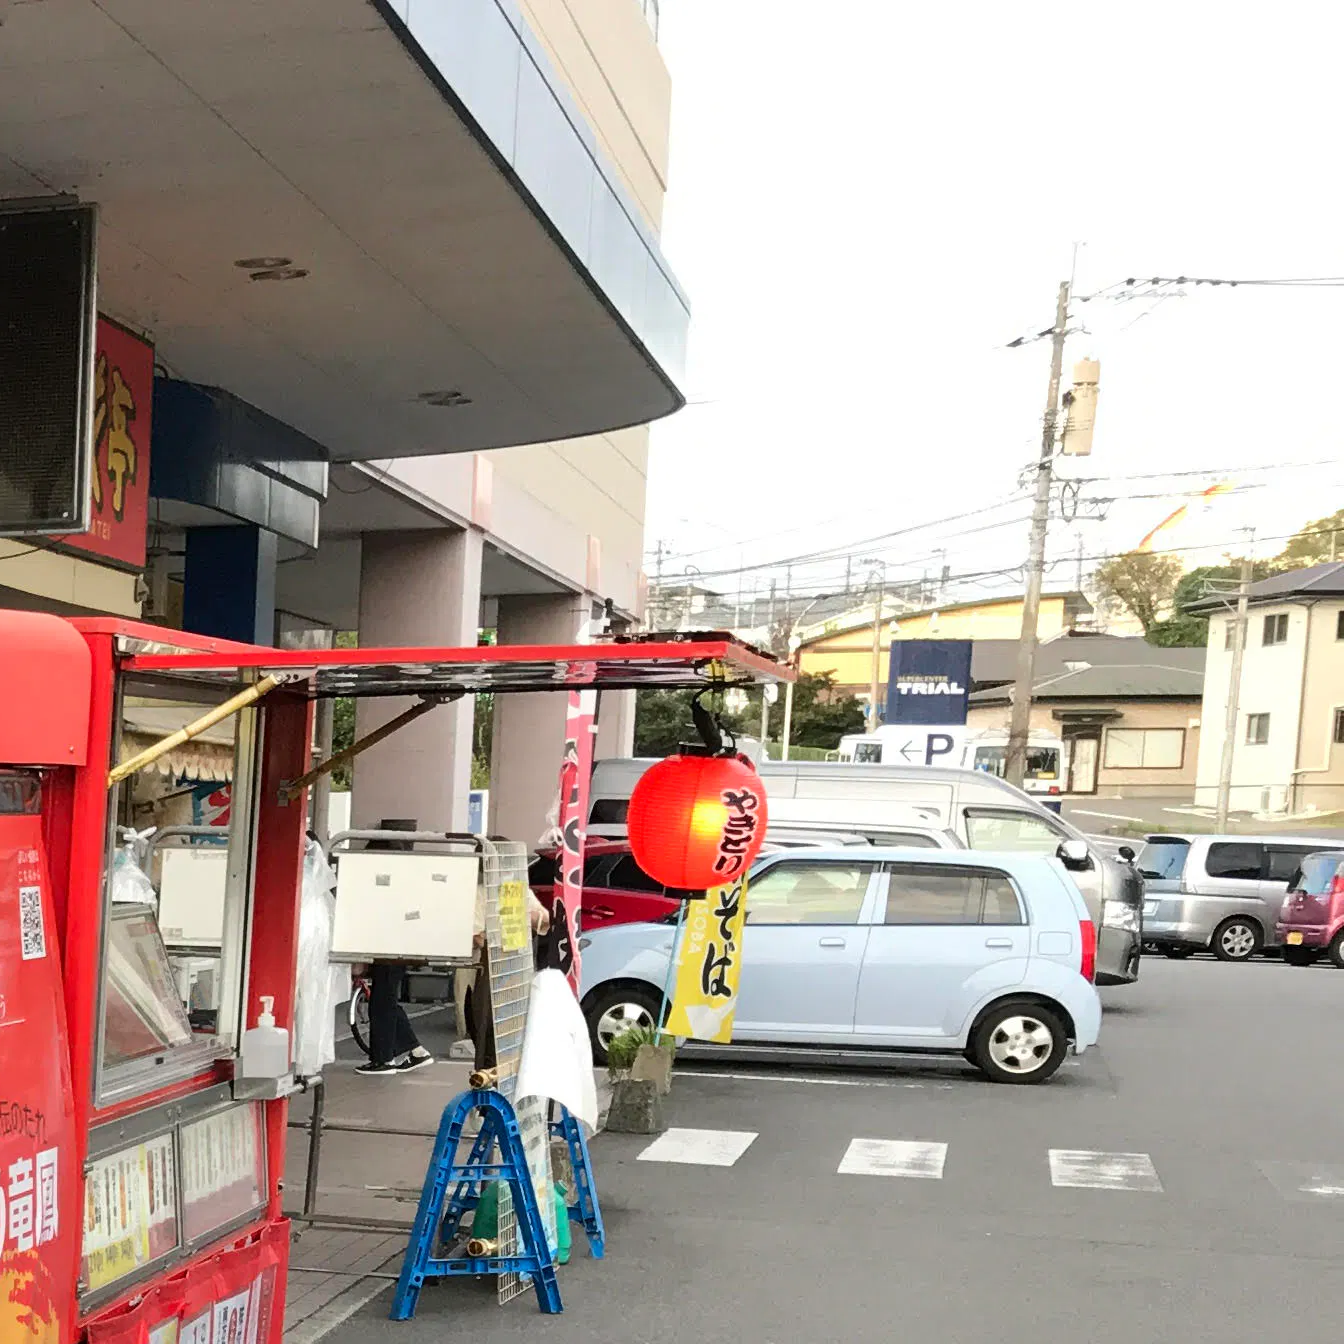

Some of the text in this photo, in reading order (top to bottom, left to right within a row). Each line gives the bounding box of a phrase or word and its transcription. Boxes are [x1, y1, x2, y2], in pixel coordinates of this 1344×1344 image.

[896, 682, 965, 695] TRIAL
[925, 733, 954, 766] P
[712, 787, 759, 876] やきとり
